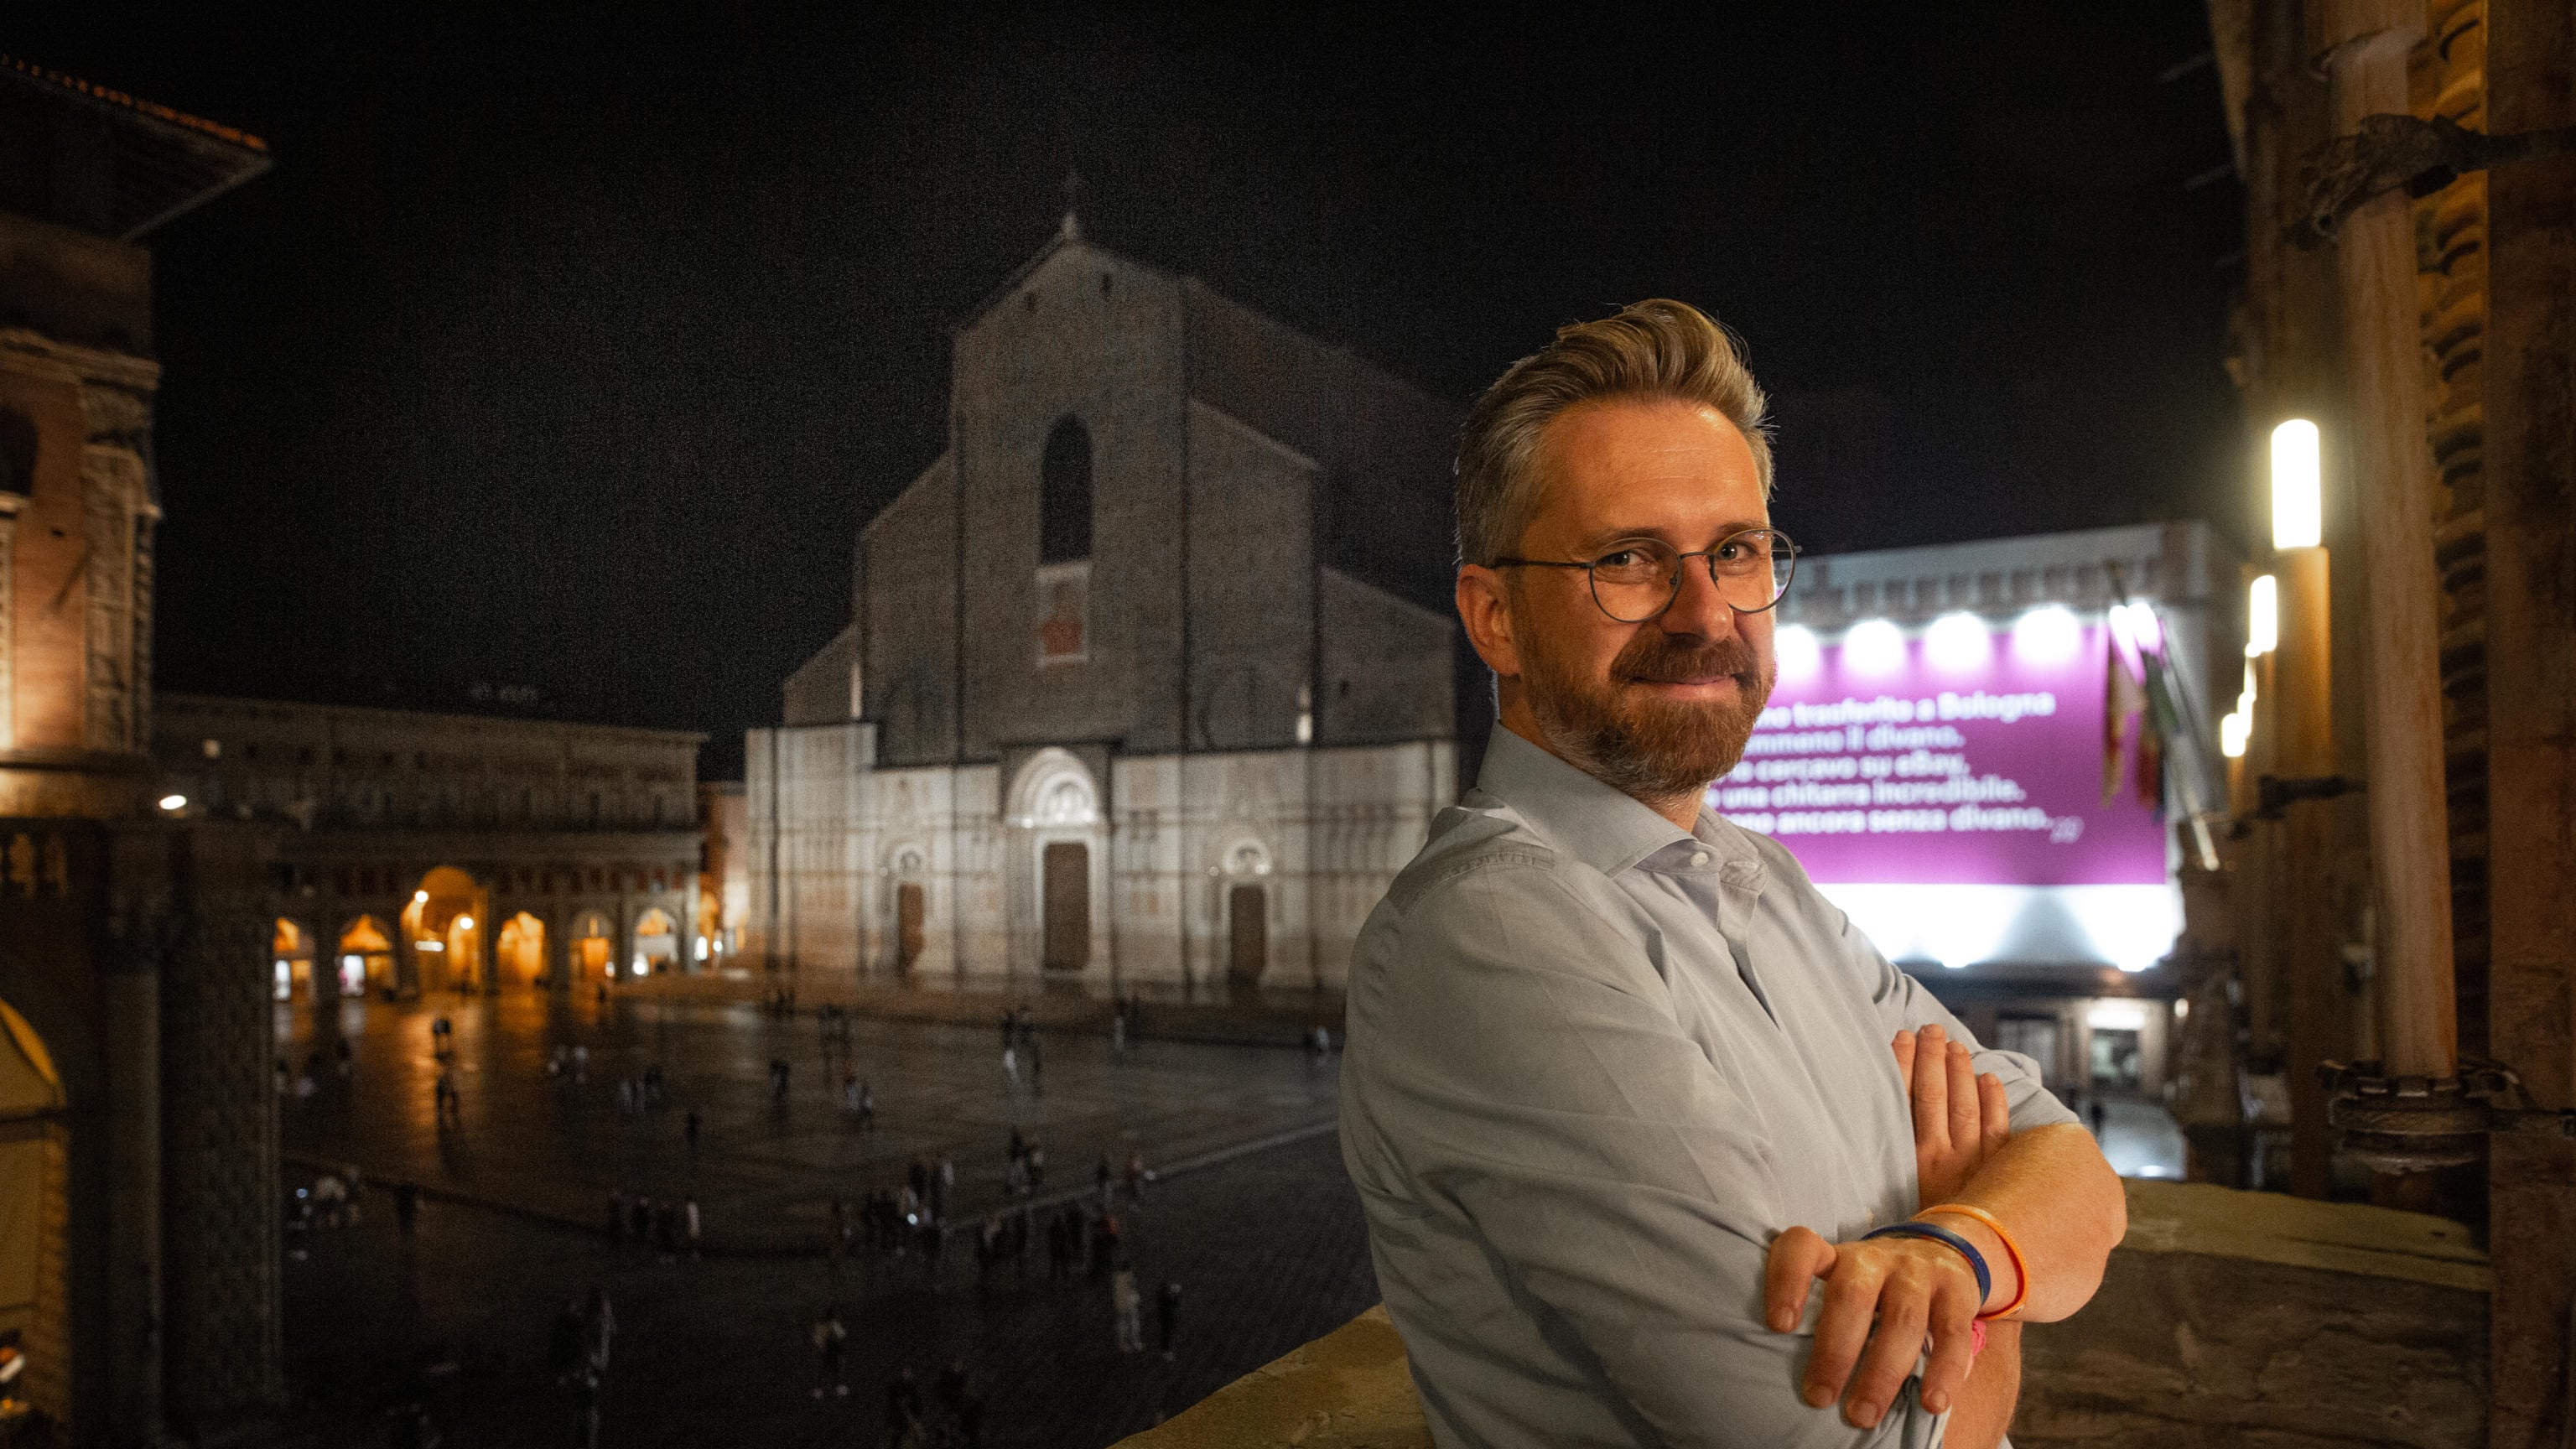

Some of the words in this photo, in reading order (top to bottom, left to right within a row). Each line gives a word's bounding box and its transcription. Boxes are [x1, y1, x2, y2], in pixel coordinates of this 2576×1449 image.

[1937, 691, 2056, 724] Bologna
[1858, 755, 1893, 779] su
[1722, 786, 1769, 808] una
[1770, 779, 1871, 808] chitarra
[1776, 810, 1867, 834] ancora
